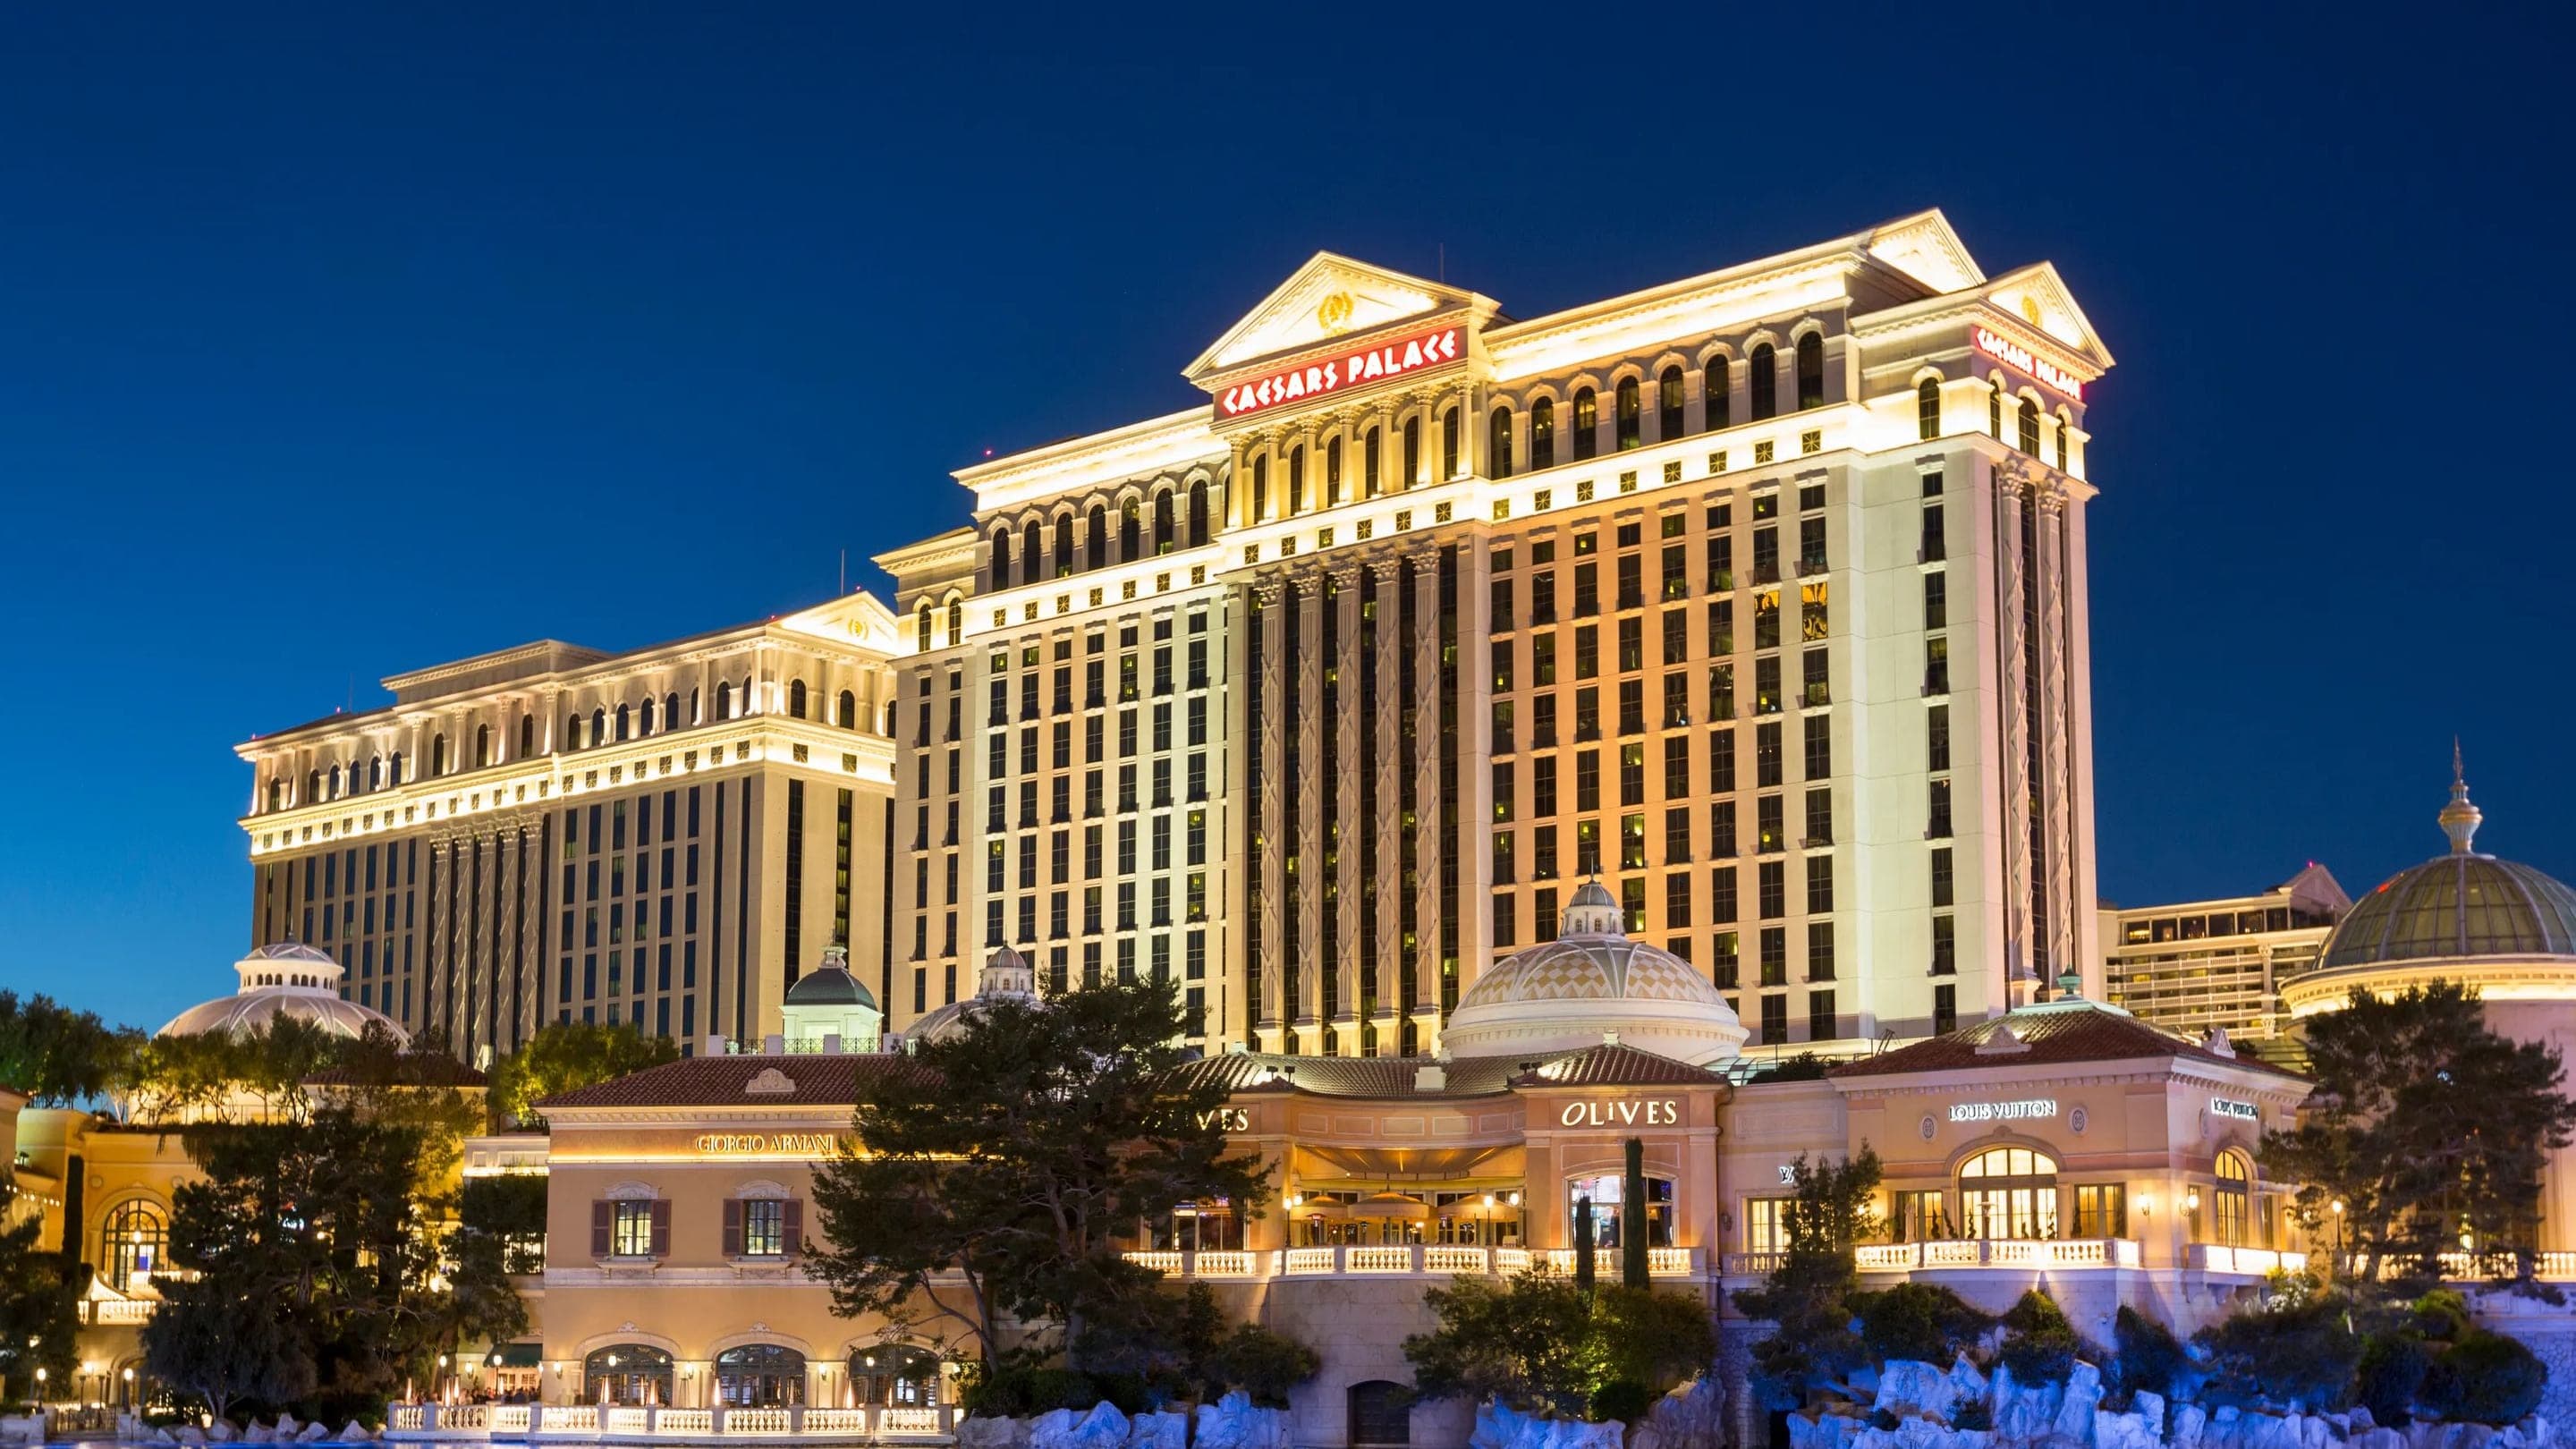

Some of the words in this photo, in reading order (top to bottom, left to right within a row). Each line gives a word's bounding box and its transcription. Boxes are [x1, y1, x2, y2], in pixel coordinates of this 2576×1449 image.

[1224, 362, 1338, 414] CAESARS
[1348, 330, 1455, 382] PALACE
[1949, 1105, 1991, 1121] LOUIS
[1992, 1100, 2056, 1118] VUITTON
[696, 1135, 765, 1153] GIORGIO
[769, 1134, 835, 1153] ARMANI
